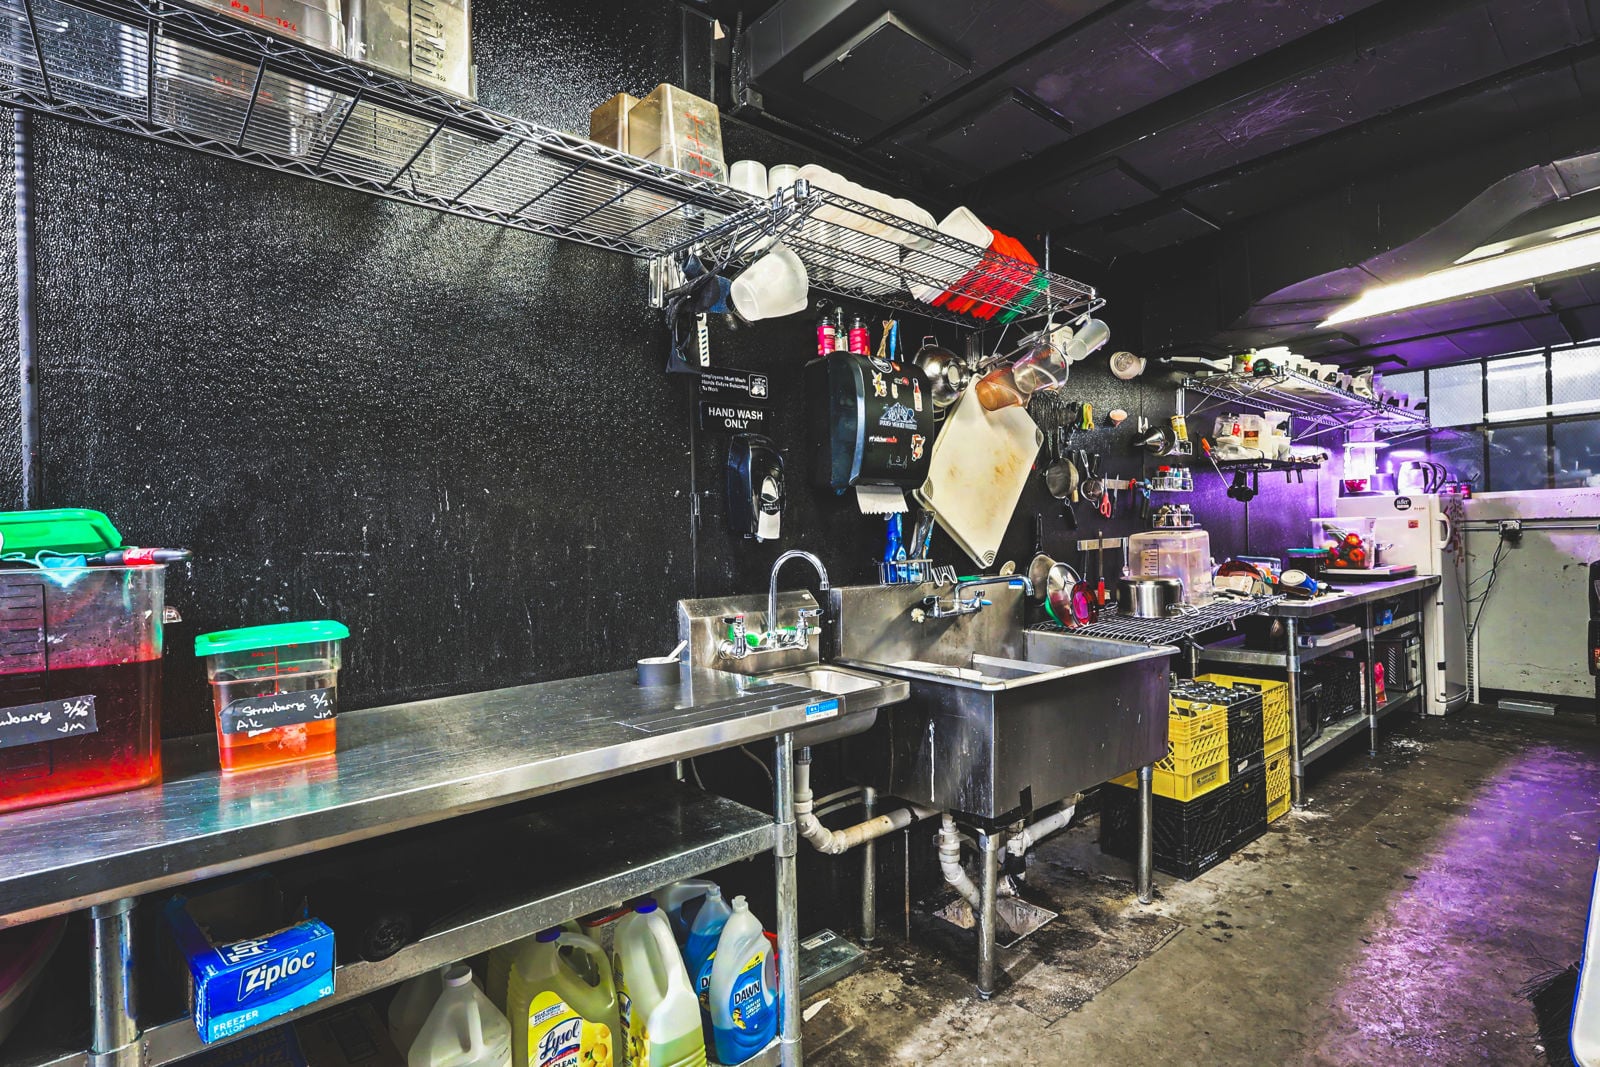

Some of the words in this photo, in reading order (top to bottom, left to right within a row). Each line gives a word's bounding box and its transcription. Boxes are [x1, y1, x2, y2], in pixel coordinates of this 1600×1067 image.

[708, 406, 735, 418] HAND
[736, 409, 763, 421] WASH
[724, 418, 749, 429] ONLY
[245, 951, 316, 993] Ziploc
[319, 986, 332, 998] 30
[734, 980, 760, 1006] DAWN
[213, 1010, 259, 1034] FREEZER
[214, 1024, 245, 1039] GALLON
[538, 1019, 580, 1061] Lysol
